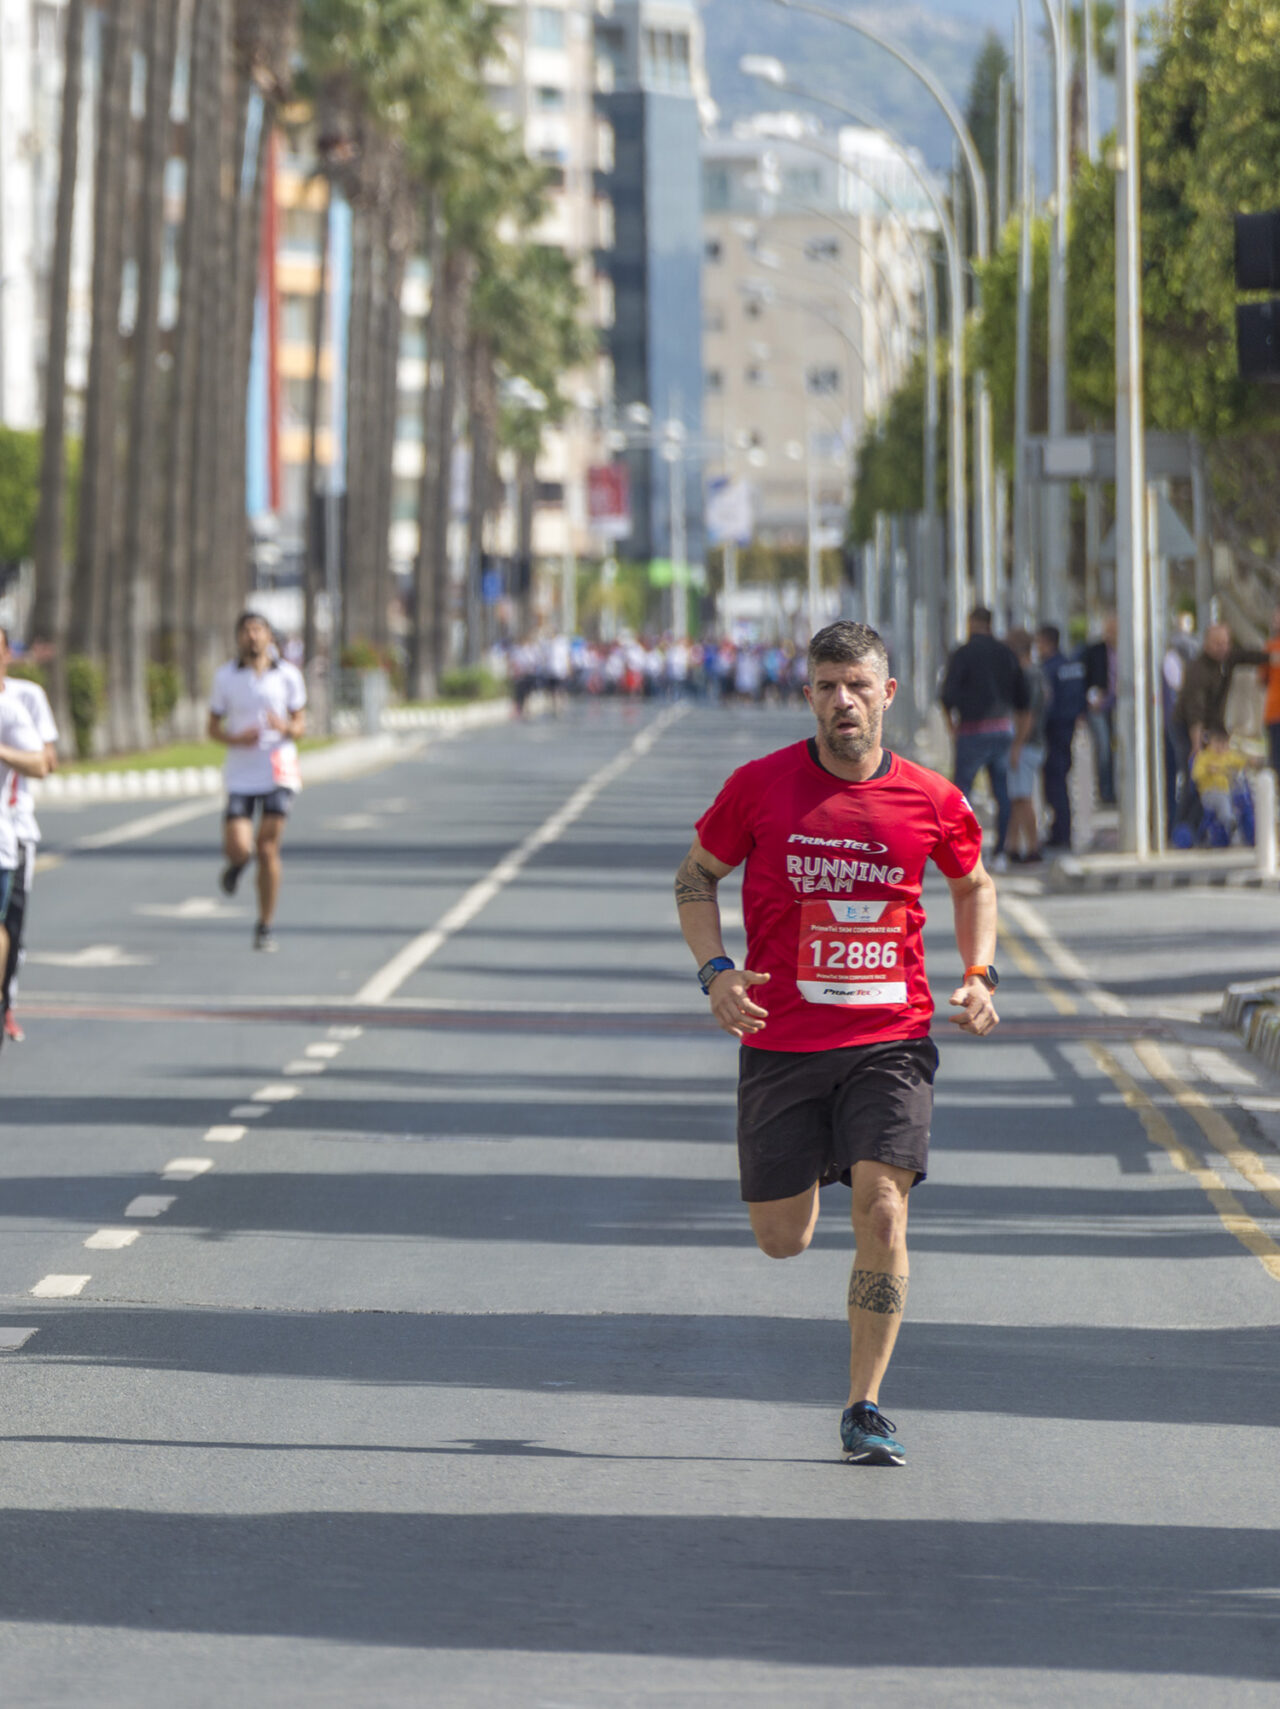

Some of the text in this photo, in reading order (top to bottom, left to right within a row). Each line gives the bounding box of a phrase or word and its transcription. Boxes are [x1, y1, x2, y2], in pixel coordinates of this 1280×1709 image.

[786, 854, 905, 885] RUNNING
[788, 875, 854, 893] TEAM
[810, 940, 898, 969] 12886
